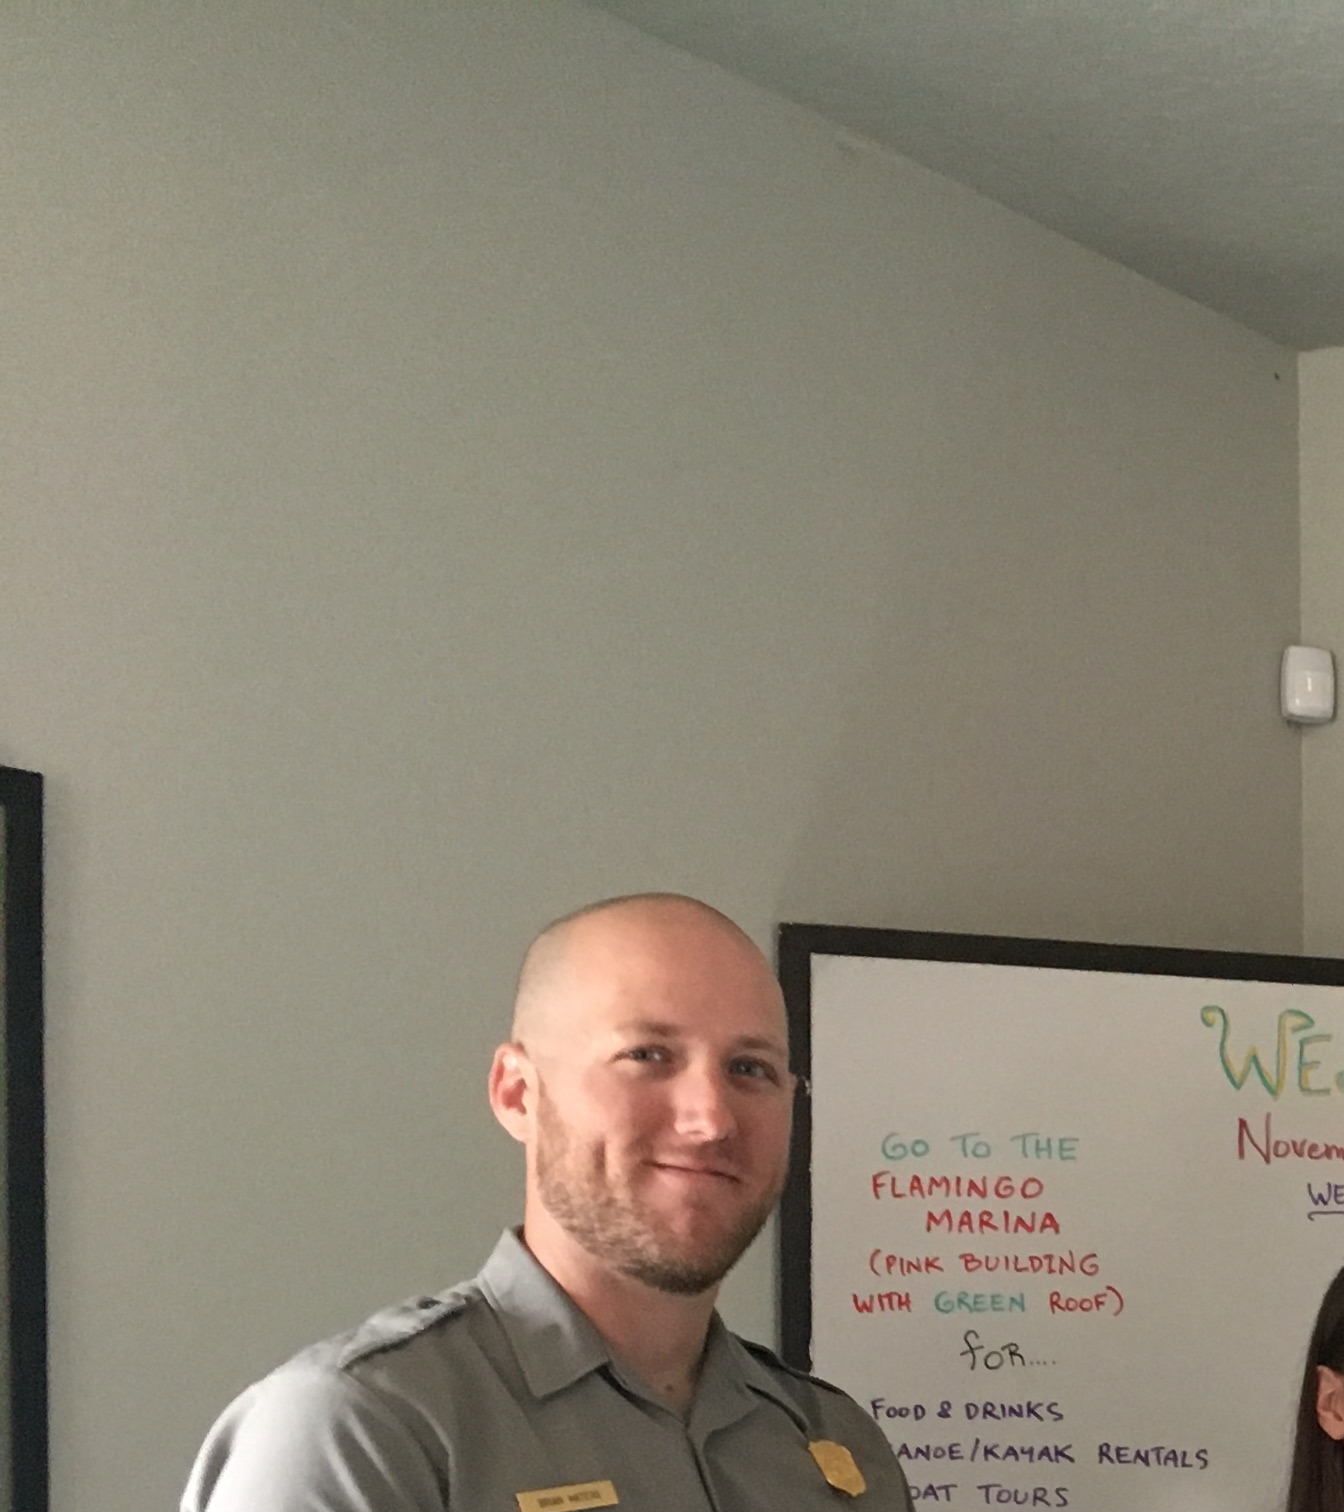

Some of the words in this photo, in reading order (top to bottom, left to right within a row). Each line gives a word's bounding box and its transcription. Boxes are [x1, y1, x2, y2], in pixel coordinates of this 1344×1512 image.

[881, 1132, 930, 1162] GO
[950, 1132, 992, 1162] TO
[1010, 1131, 1081, 1163] THE
[871, 1171, 1045, 1201] FLAMINGO
[926, 1209, 1061, 1236] MARINA
[869, 1248, 944, 1277] (PINK
[959, 1250, 1100, 1278] BUILDING
[851, 1291, 912, 1315] WITH
[933, 1292, 1027, 1315] GREEN
[1049, 1284, 1125, 1318] ROOF)
[870, 1397, 927, 1422] FOOD
[937, 1400, 953, 1419] &
[965, 1400, 1065, 1423] DRINKS
[893, 1437, 1077, 1465] ANOE/KAYAK
[1098, 1442, 1210, 1470] RENTALS
[908, 1483, 959, 1503] OAT
[976, 1482, 1070, 1508] TOURS
